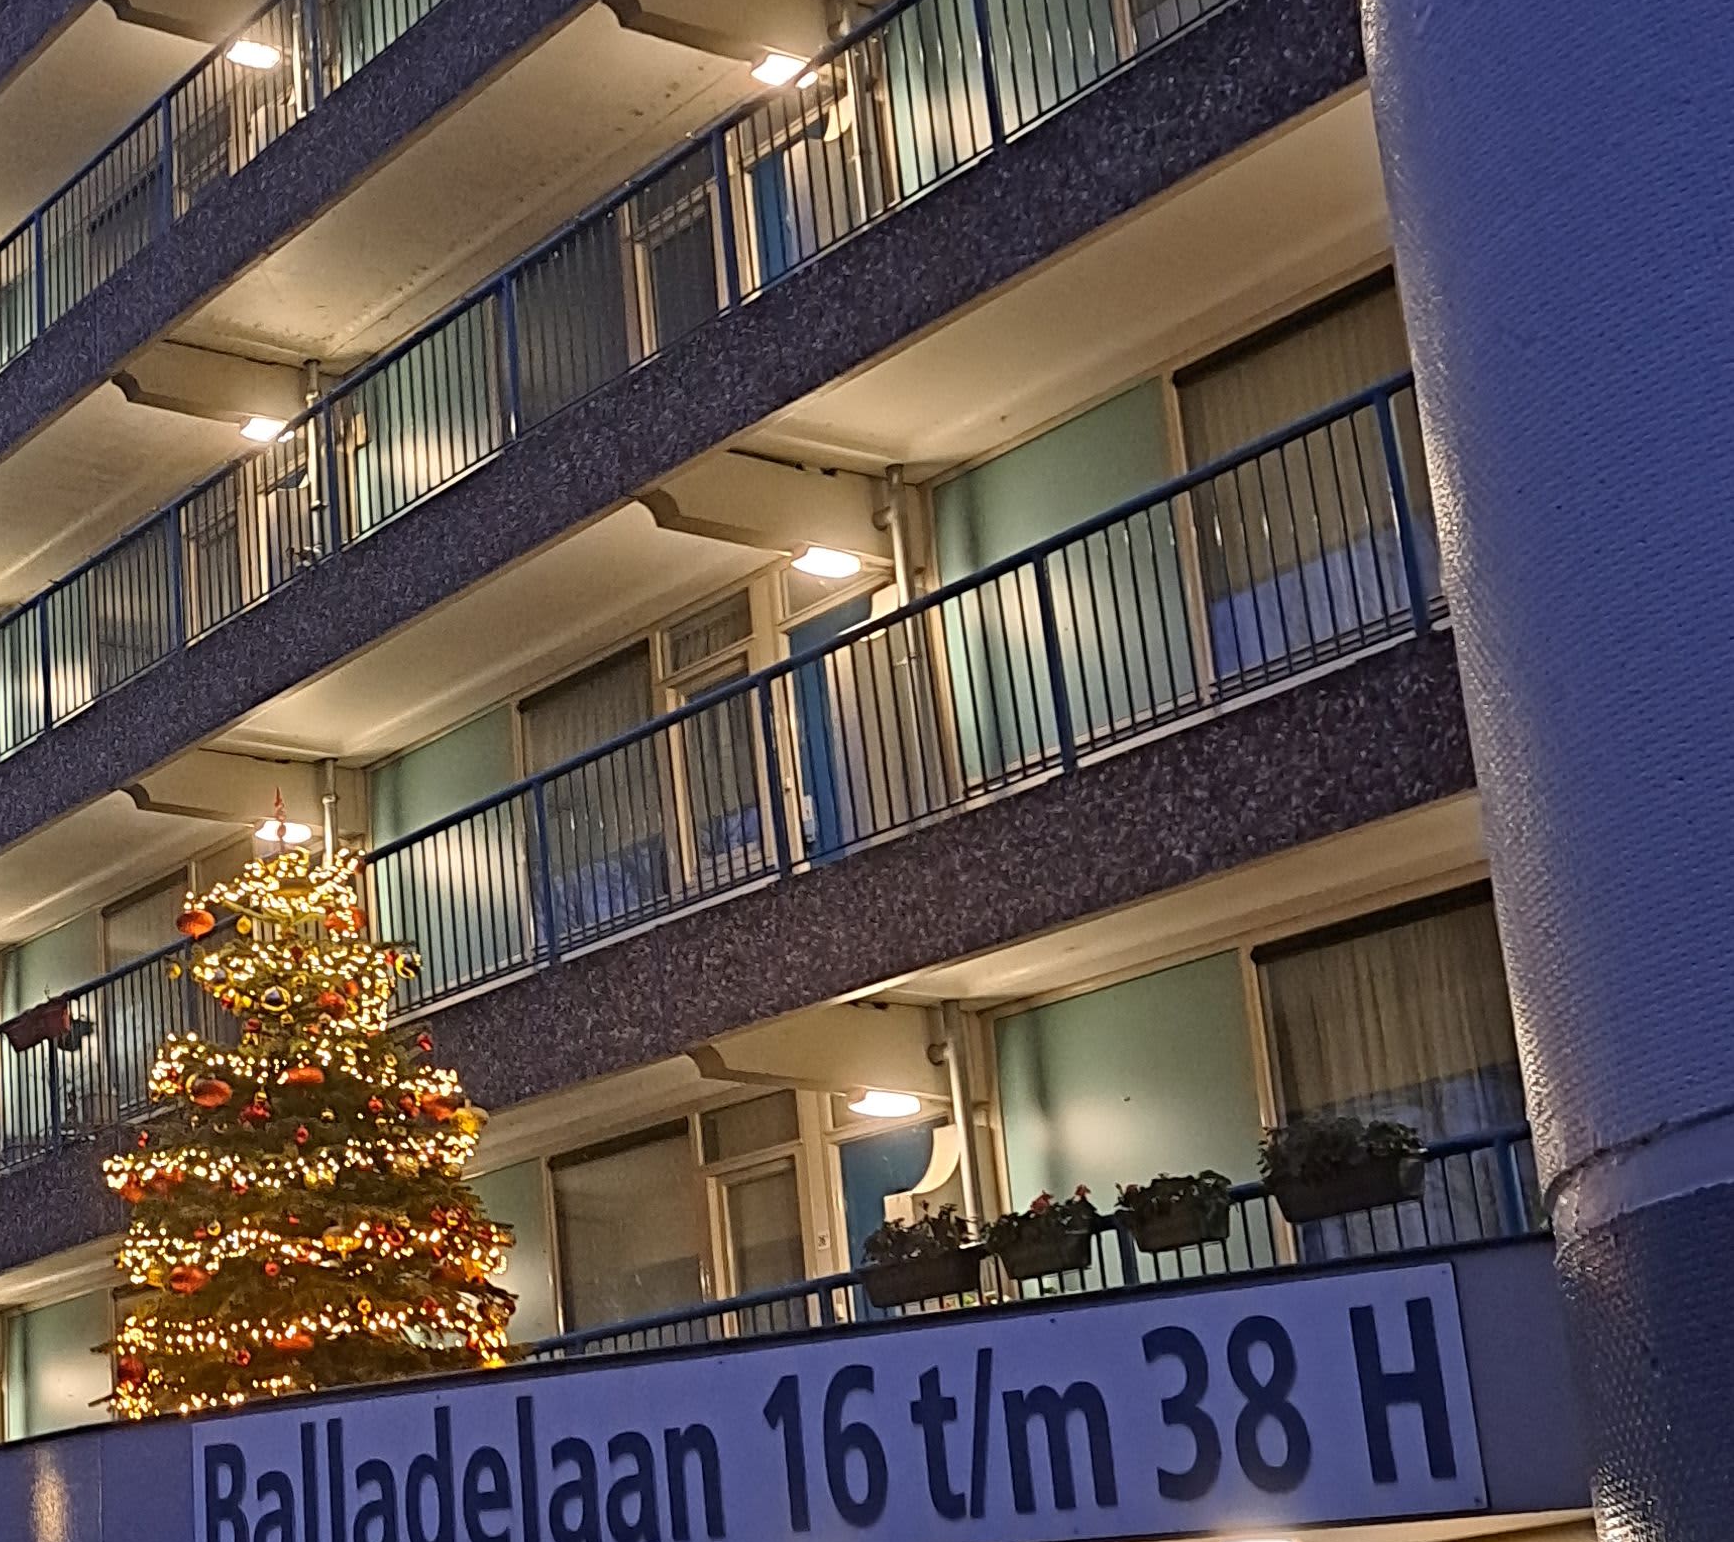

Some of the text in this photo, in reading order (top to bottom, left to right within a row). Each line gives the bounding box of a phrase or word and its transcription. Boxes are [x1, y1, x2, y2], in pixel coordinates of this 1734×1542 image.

[763, 1364, 888, 1532] 16
[910, 1347, 1118, 1520] t/m
[1142, 1314, 1311, 1501] 38
[1349, 1296, 1456, 1484] H
